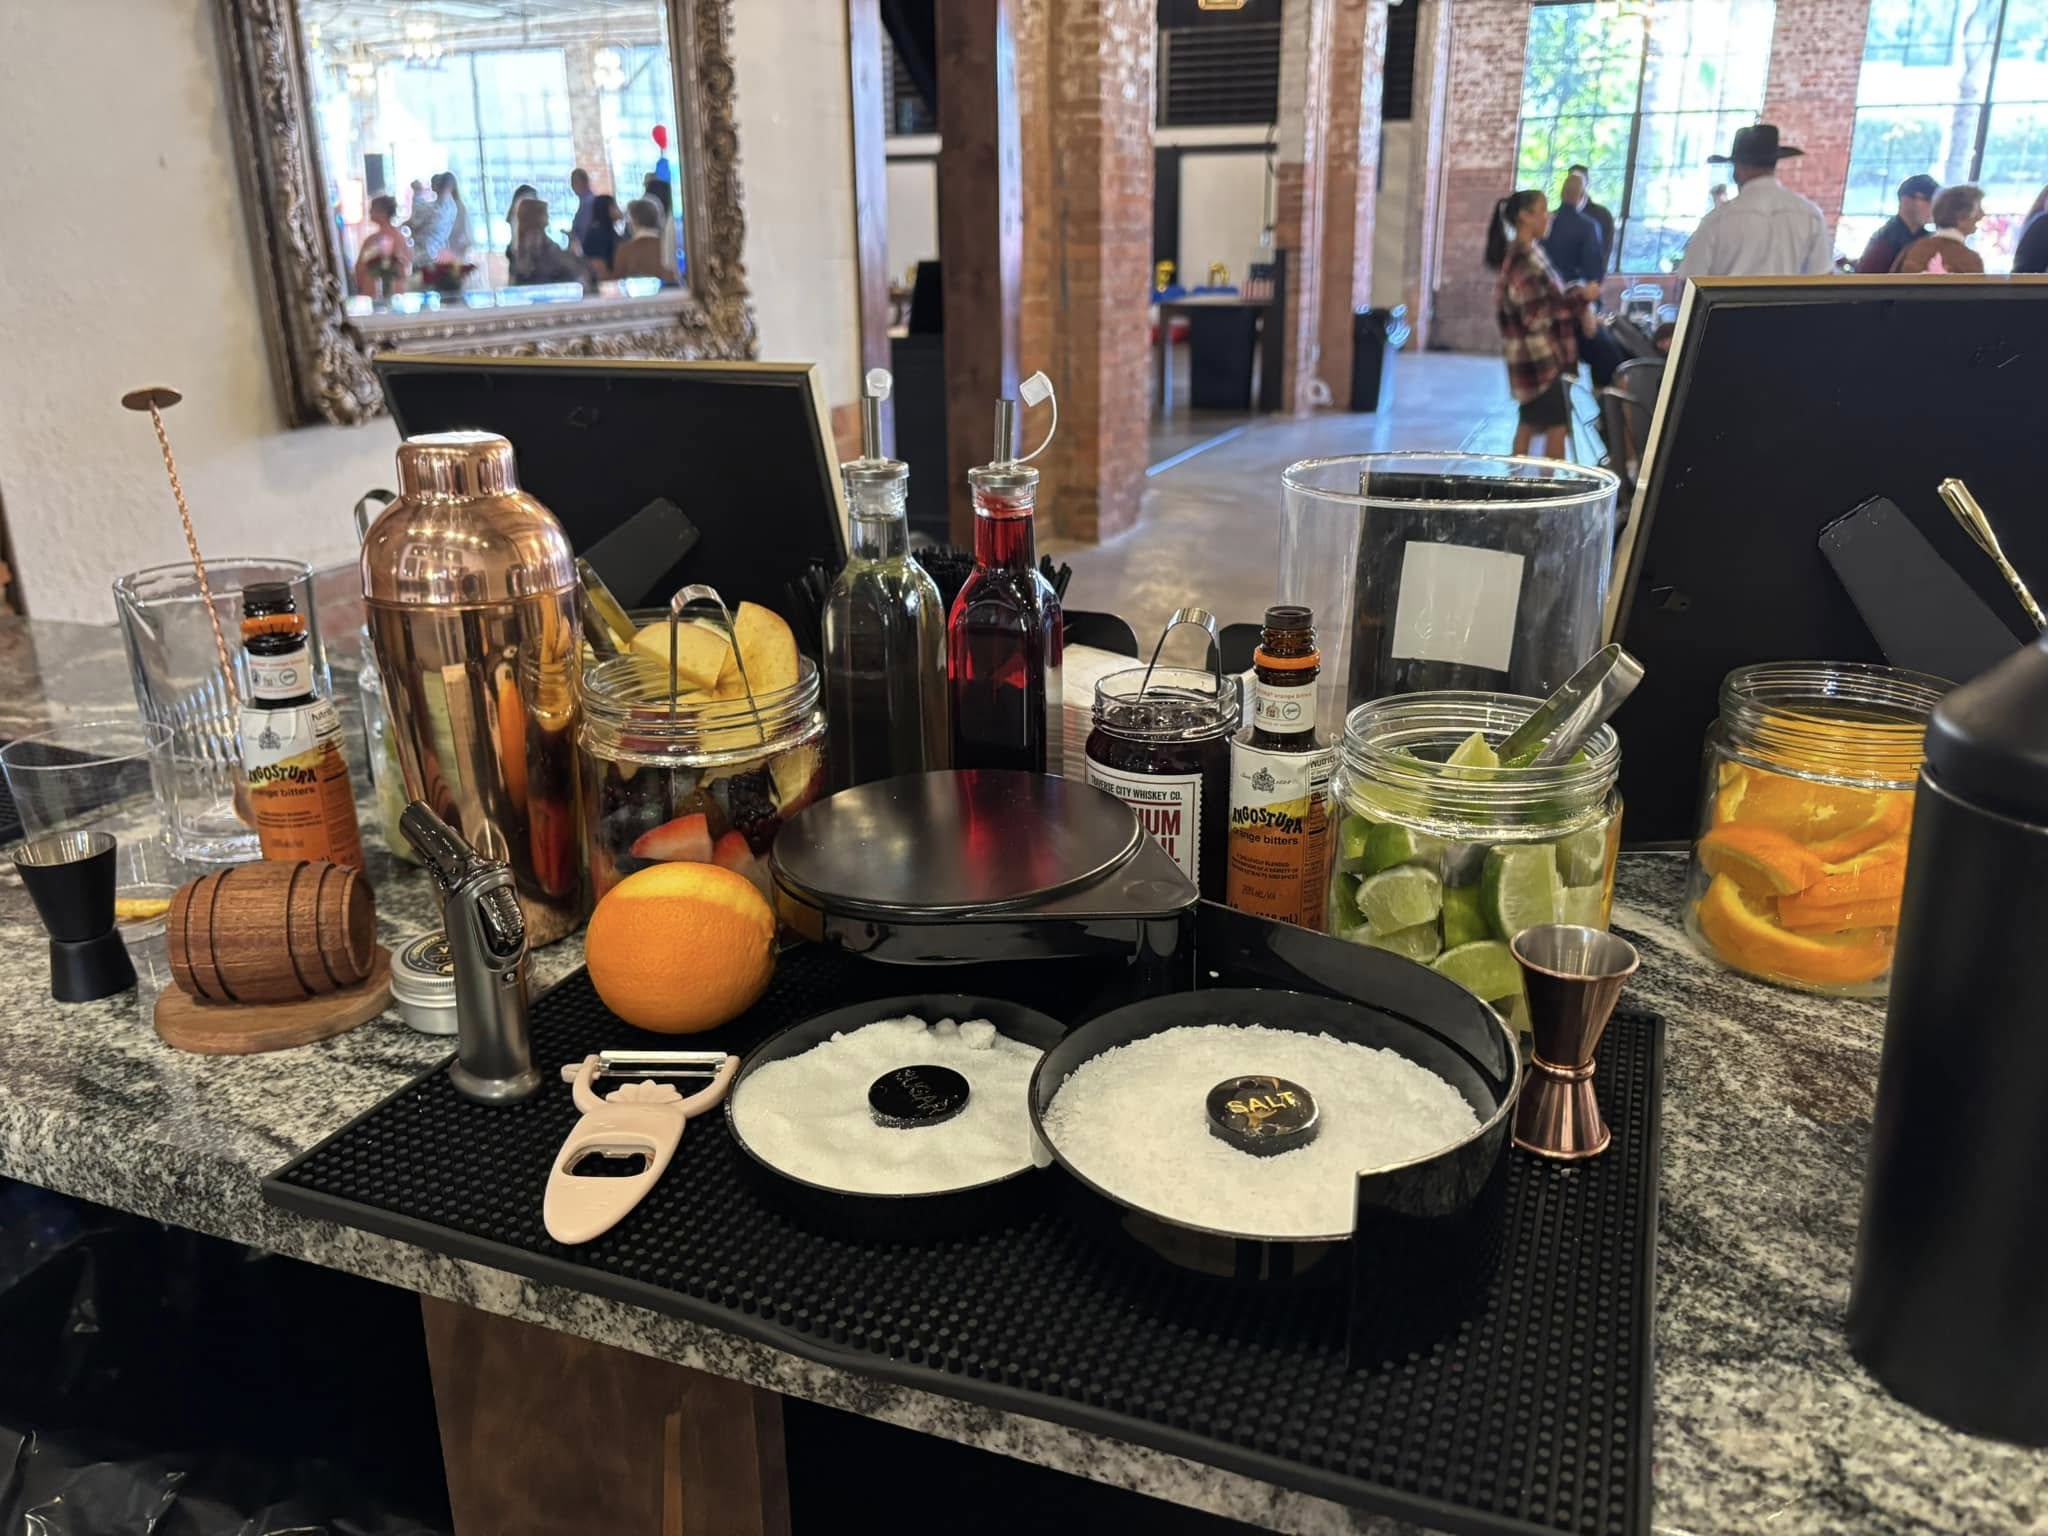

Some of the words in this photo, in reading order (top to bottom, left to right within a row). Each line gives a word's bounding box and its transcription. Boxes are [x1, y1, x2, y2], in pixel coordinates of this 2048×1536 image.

[1116, 785, 1132, 798] CITY
[1133, 788, 1168, 800] WHISKEY
[1170, 790, 1182, 801] CO.
[1232, 806, 1303, 834] ANGOSTURA
[1232, 827, 1261, 844] orange
[1263, 834, 1299, 846] bitters
[1226, 1091, 1296, 1114] SALT
